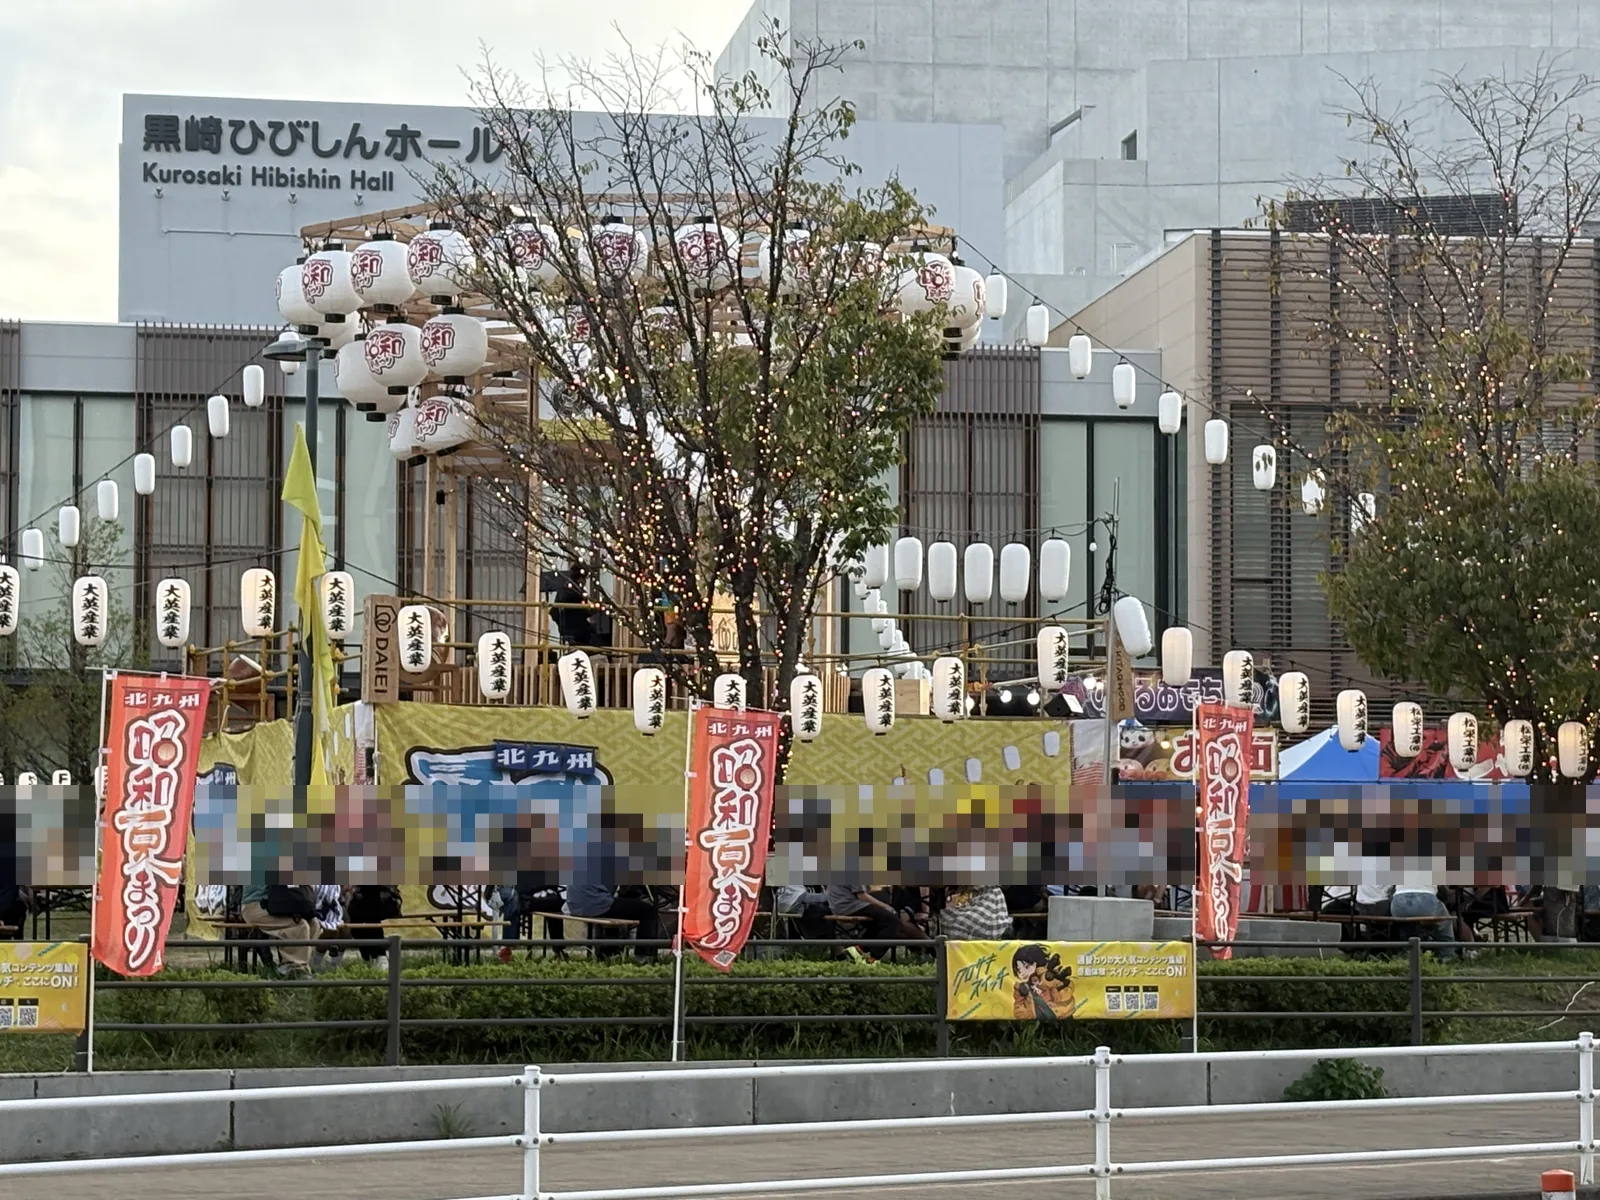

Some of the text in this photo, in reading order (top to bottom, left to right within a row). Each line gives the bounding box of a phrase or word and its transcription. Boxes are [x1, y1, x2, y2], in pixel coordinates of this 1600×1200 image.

[143, 114, 503, 163] 黒崎ひびしんホール
[143, 162, 393, 192] Kurosaki Hibishin Hall
[81, 583, 100, 639] 大英産業
[163, 585, 181, 640] 大英産業
[258, 575, 273, 629] 大英産業
[328, 578, 345, 631] 大英産業
[375, 637, 388, 694] DAIEI
[406, 612, 424, 666] 大英産業
[490, 639, 507, 692] 大英産業
[124, 692, 200, 708] 北九州
[571, 658, 593, 711] 大英産業
[648, 675, 664, 728] 大英産業
[801, 681, 819, 733] 大英産業
[878, 675, 894, 728] 大英産業
[947, 663, 962, 715] 大英産業
[708, 721, 773, 738] 北九州
[1203, 717, 1248, 735] 北九州
[498, 748, 593, 770] 北九州
